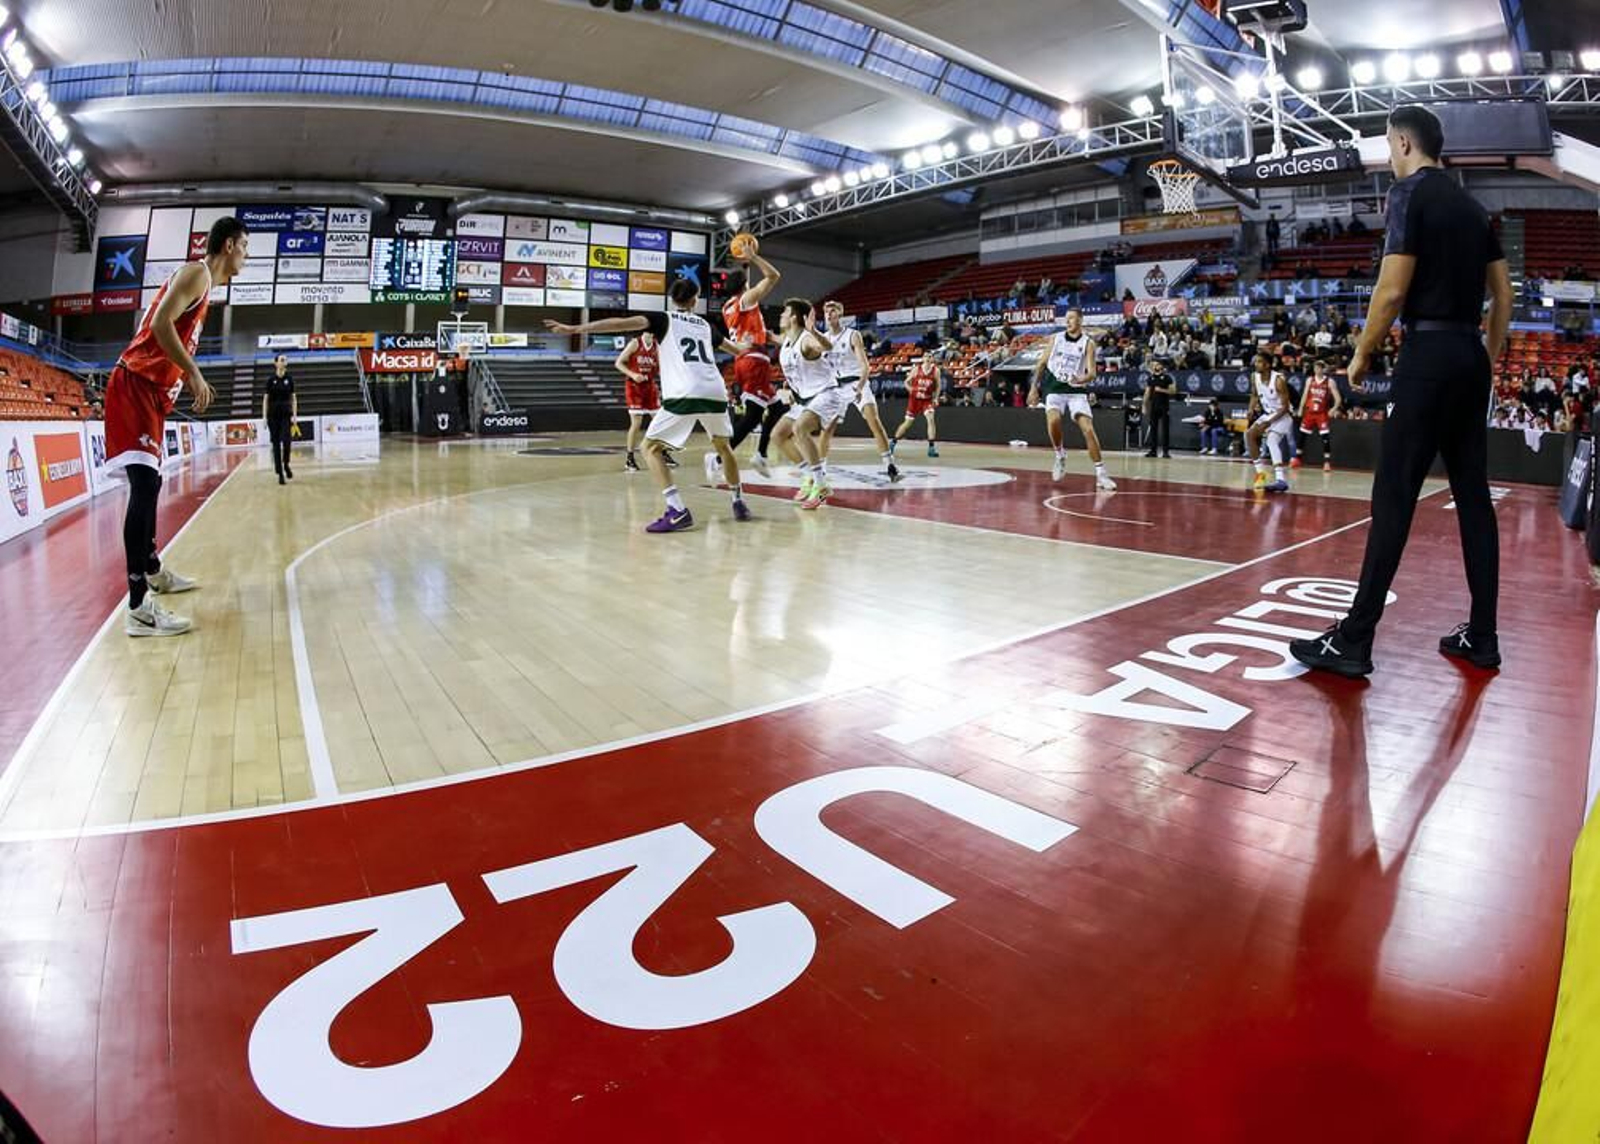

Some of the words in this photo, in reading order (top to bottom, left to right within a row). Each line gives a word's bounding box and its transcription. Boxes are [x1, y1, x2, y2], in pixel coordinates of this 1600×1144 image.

[1256, 156, 1338, 179] endesa
[397, 336, 437, 349] CaixaBa
[371, 353, 418, 368] Macsa
[421, 353, 435, 368] id
[484, 416, 528, 427] endesa
